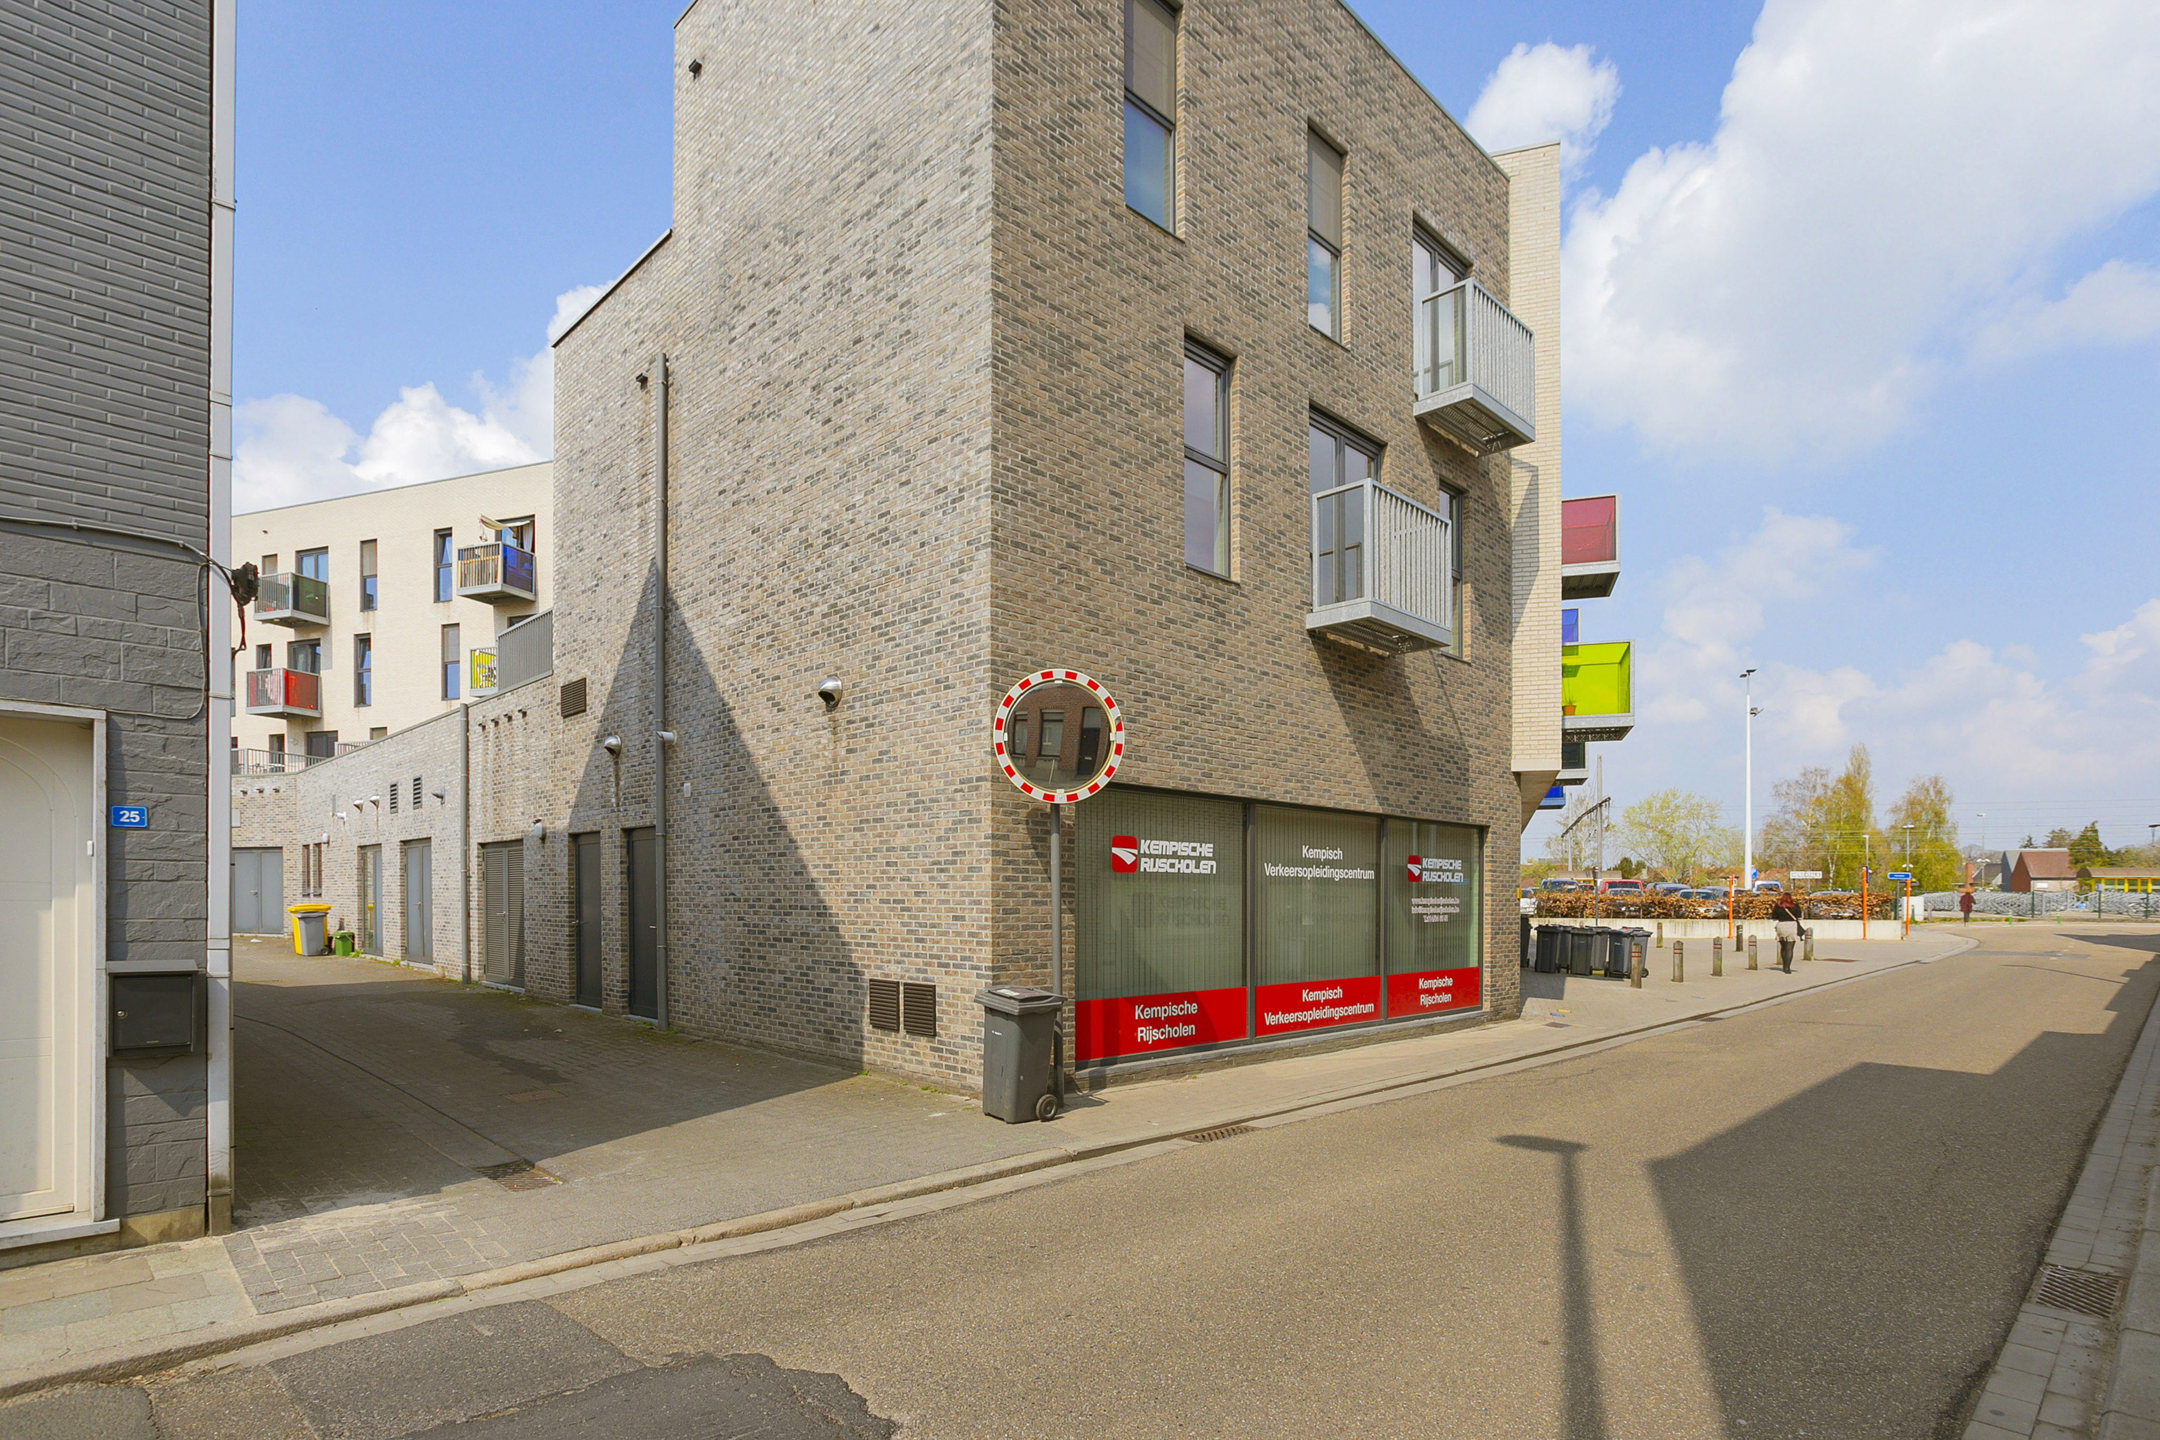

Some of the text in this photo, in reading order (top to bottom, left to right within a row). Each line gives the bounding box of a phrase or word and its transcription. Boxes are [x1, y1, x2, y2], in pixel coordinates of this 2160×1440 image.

[120, 810, 140, 823] 25
[1140, 839, 1214, 857] KEMPISCHE
[1302, 845, 1343, 862] Kempisch
[1264, 863, 1375, 881] Verkeersopleidingscentrum
[1422, 857, 1462, 870] KEMPISCHE
[1419, 975, 1453, 991] Kempische
[1302, 986, 1343, 1003] Kempisch
[1420, 992, 1452, 1008] Rijscholen
[1135, 1000, 1198, 1021] Kempische
[1264, 1002, 1375, 1026] Verkeersopleidingscentrum
[1137, 1022, 1196, 1045] Rijscholen
